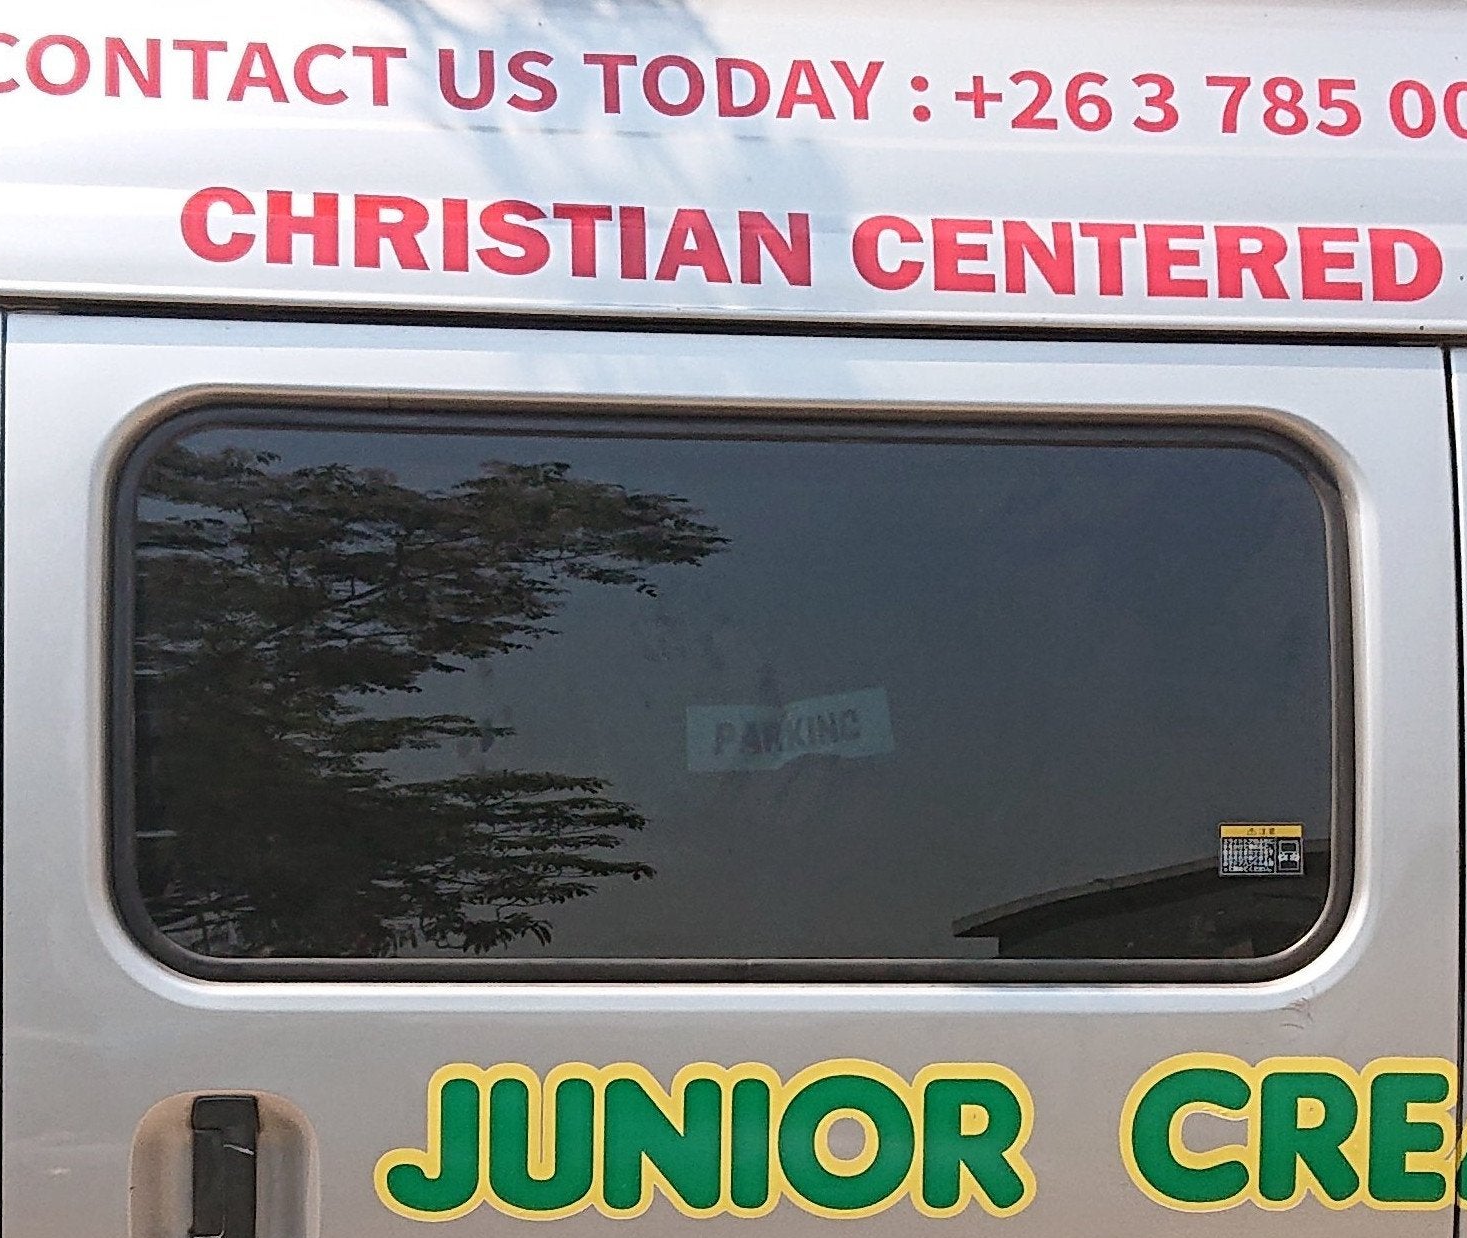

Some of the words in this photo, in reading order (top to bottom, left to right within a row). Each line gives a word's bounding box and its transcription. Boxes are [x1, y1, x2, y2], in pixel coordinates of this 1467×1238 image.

[438, 49, 558, 113] US
[583, 52, 884, 121] TODAY
[1206, 75, 1363, 138] 785
[179, 186, 813, 287] CHRISTIAN
[851, 215, 1443, 303] CENTERED
[375, 1062, 1036, 1219] JUNIOR
